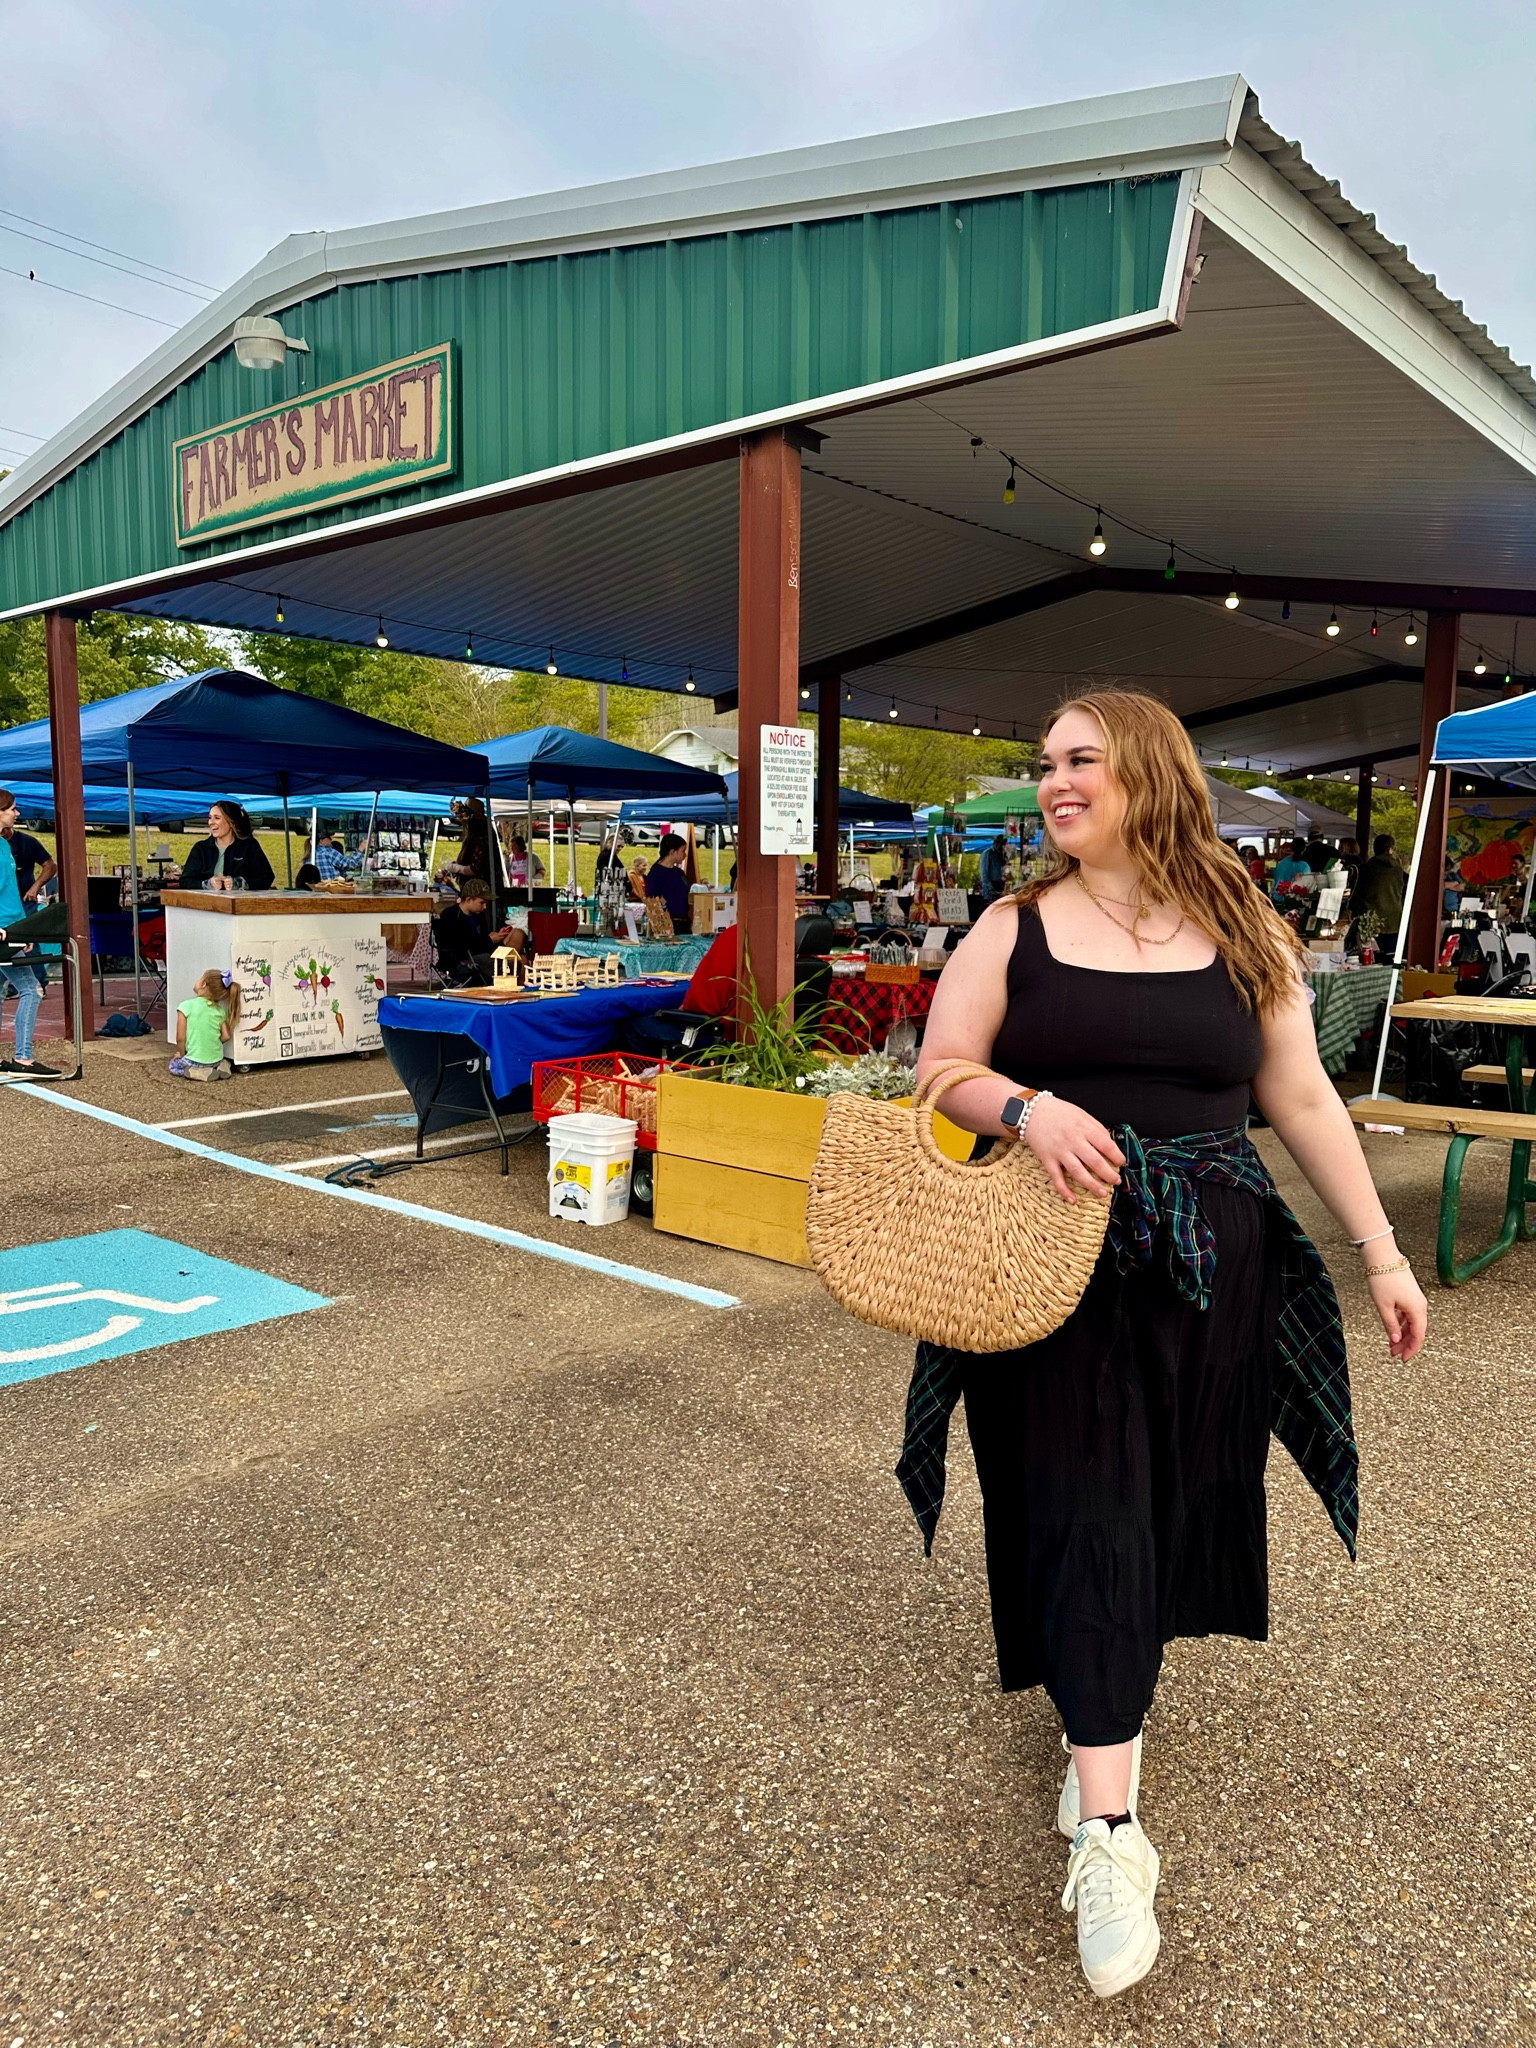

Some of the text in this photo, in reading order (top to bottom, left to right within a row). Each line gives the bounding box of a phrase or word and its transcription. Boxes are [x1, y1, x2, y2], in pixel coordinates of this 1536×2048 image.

[181, 360, 441, 533] FARMER'S MARKET
[769, 732, 806, 748] NOTICE
[769, 748, 783, 756] PERSONS
[317, 945, 345, 968] Harvest
[292, 1010, 325, 1024] FOLLOW ME ON
